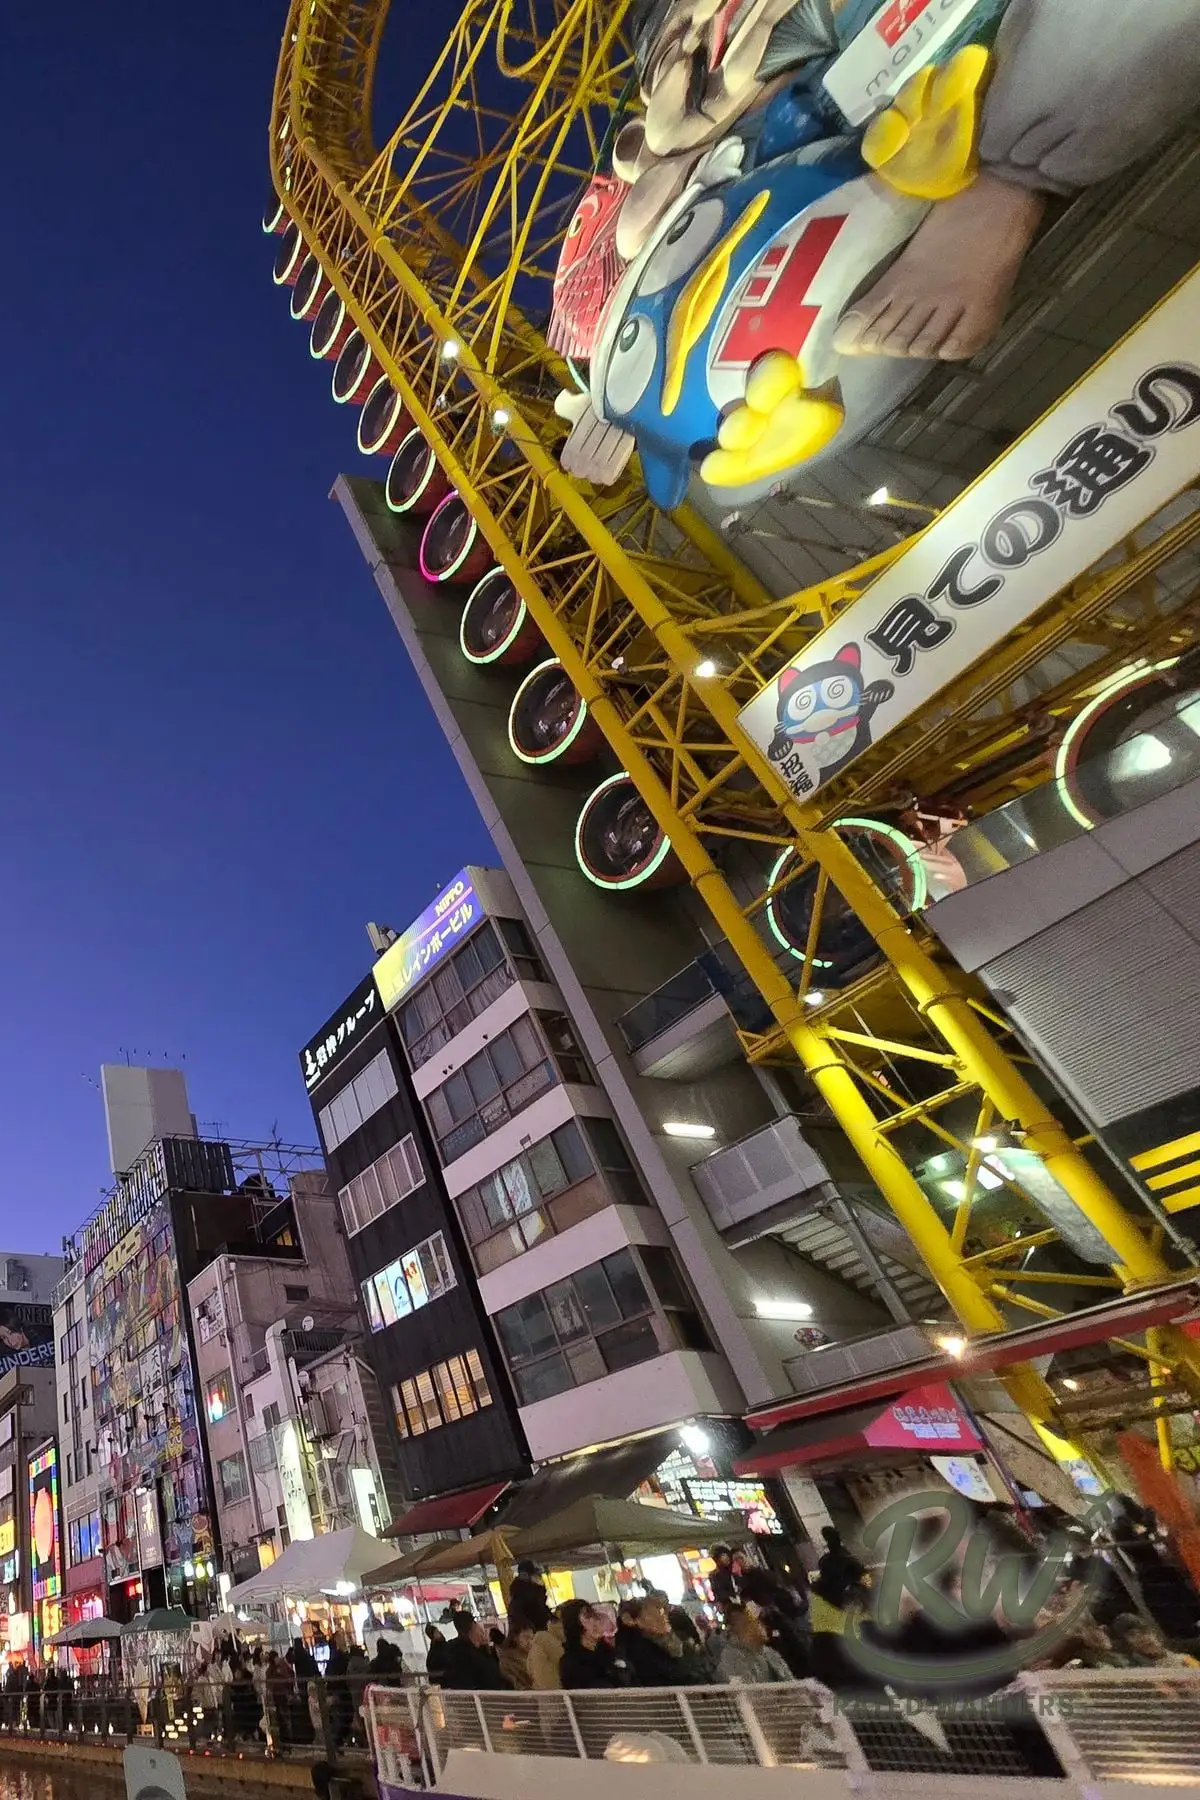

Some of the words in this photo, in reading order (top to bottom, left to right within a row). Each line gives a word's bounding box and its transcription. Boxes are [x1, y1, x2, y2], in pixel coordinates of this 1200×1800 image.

[866, 361, 1200, 677] 見ての通り
[435, 881, 464, 917] NIPPO
